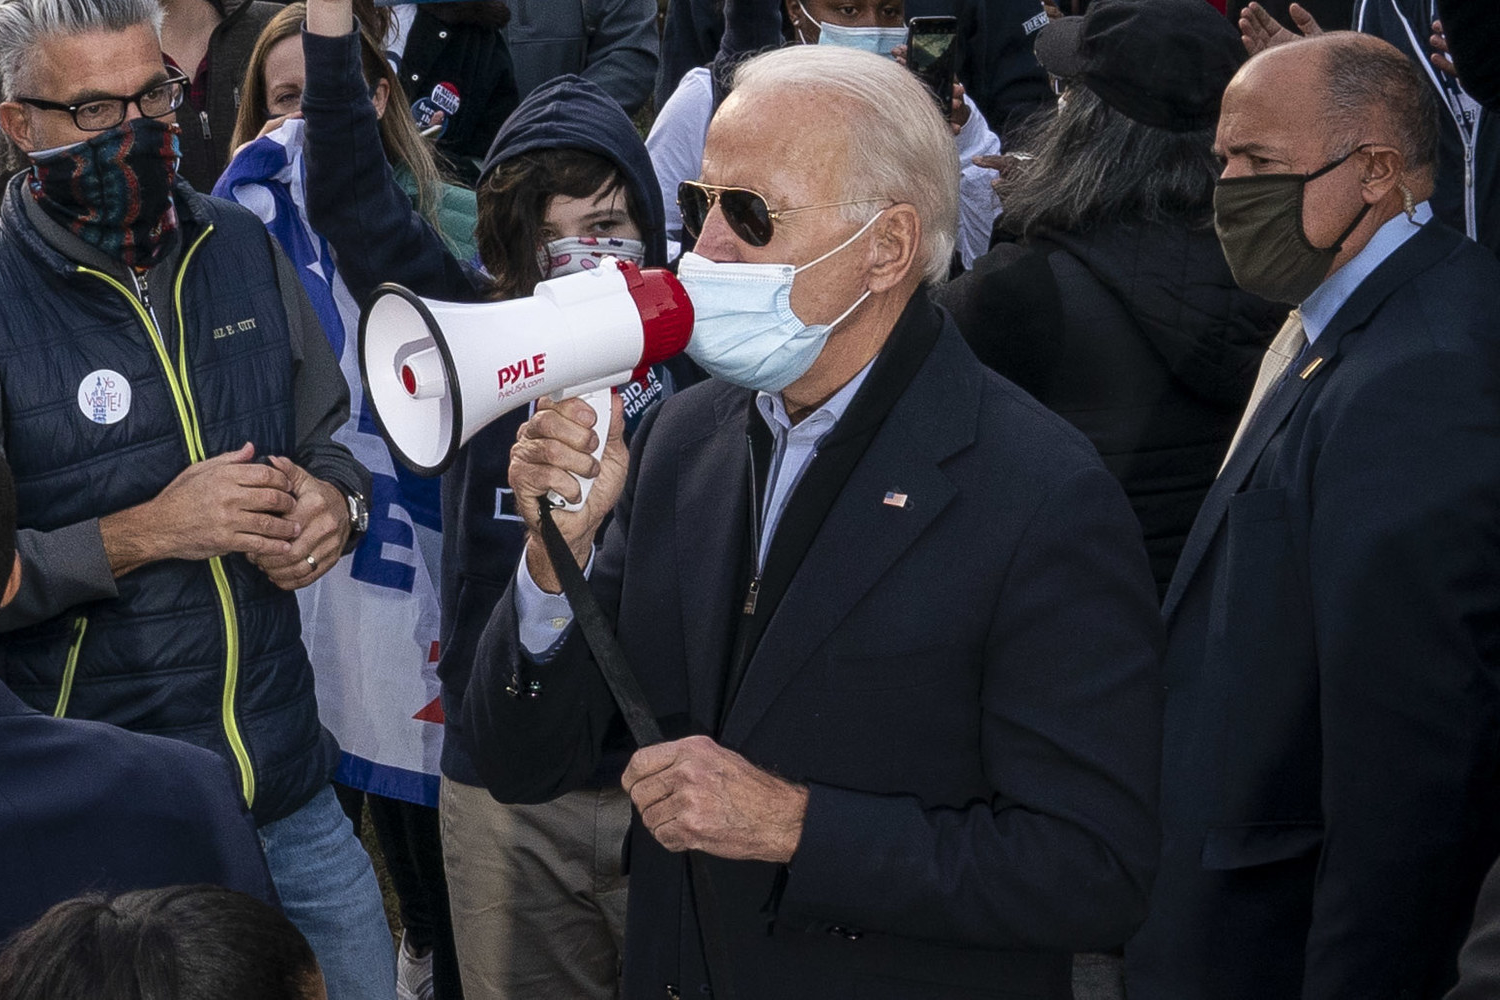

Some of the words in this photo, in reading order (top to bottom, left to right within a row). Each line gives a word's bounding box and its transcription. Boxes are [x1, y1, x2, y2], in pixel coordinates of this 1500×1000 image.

[497, 353, 545, 390] PYLE
[621, 366, 658, 406] BIDEN
[624, 379, 663, 418] HARRIS
